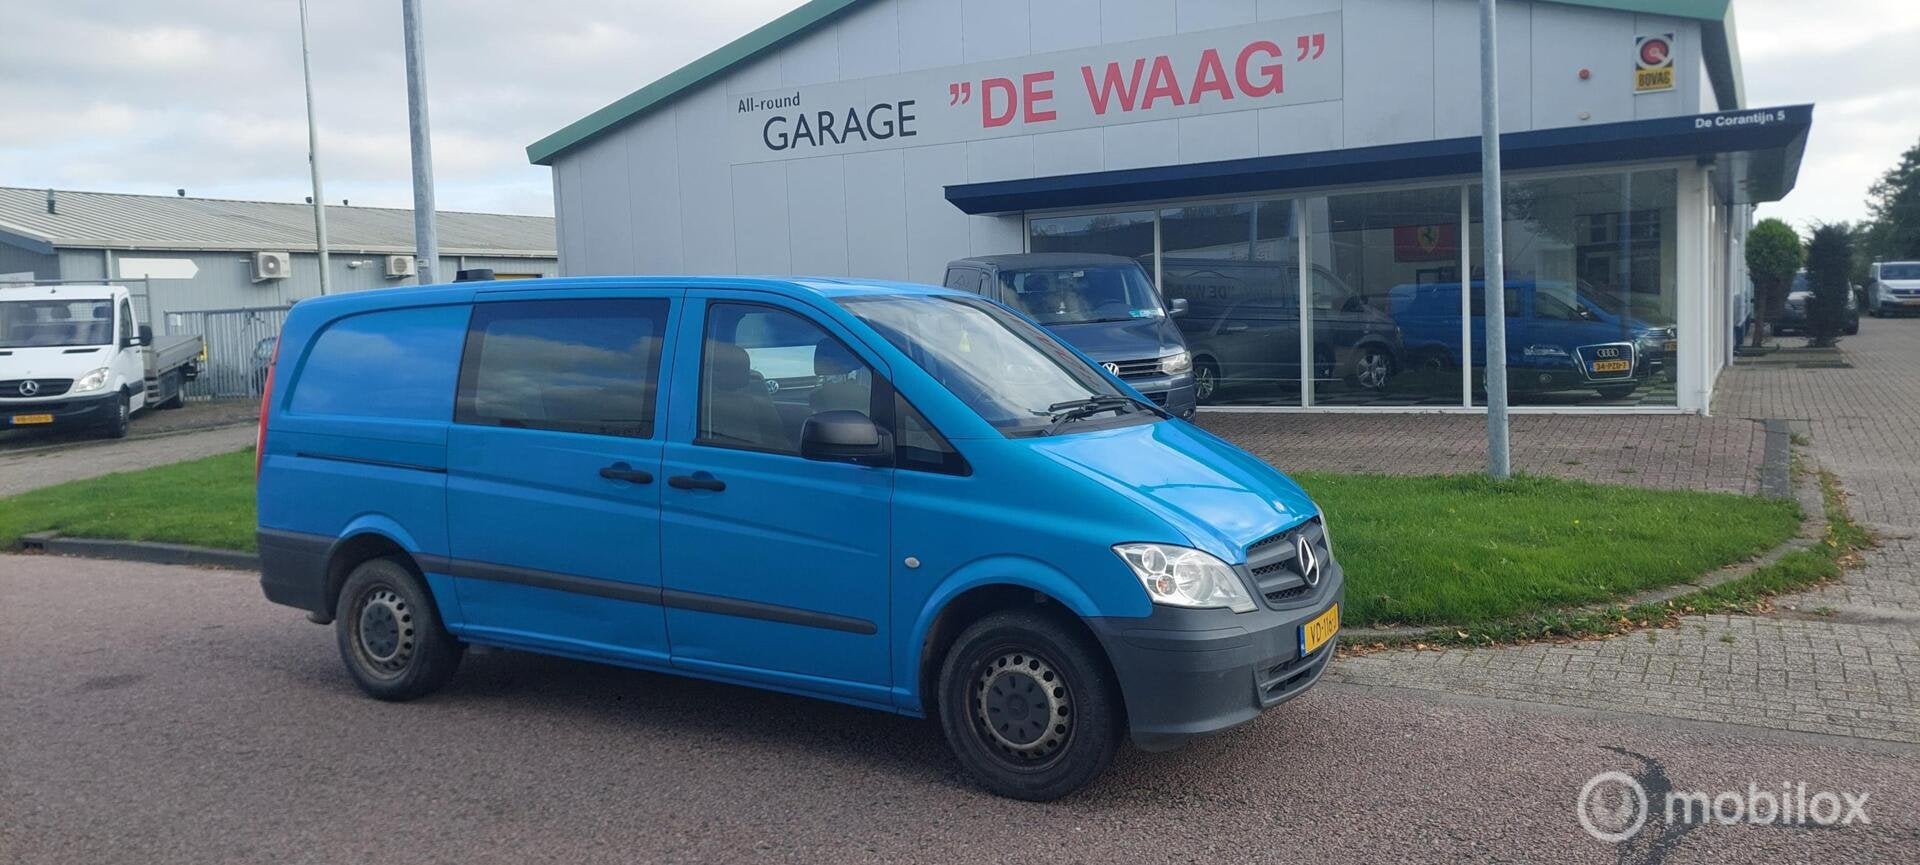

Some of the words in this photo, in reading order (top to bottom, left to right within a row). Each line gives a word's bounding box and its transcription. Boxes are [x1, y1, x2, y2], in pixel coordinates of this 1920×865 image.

[737, 91, 801, 113] All-round
[762, 99, 917, 151] GARAGE
[1694, 117, 1713, 129] De
[1714, 112, 1774, 126] Corantijn
[1777, 110, 1785, 121] 5
